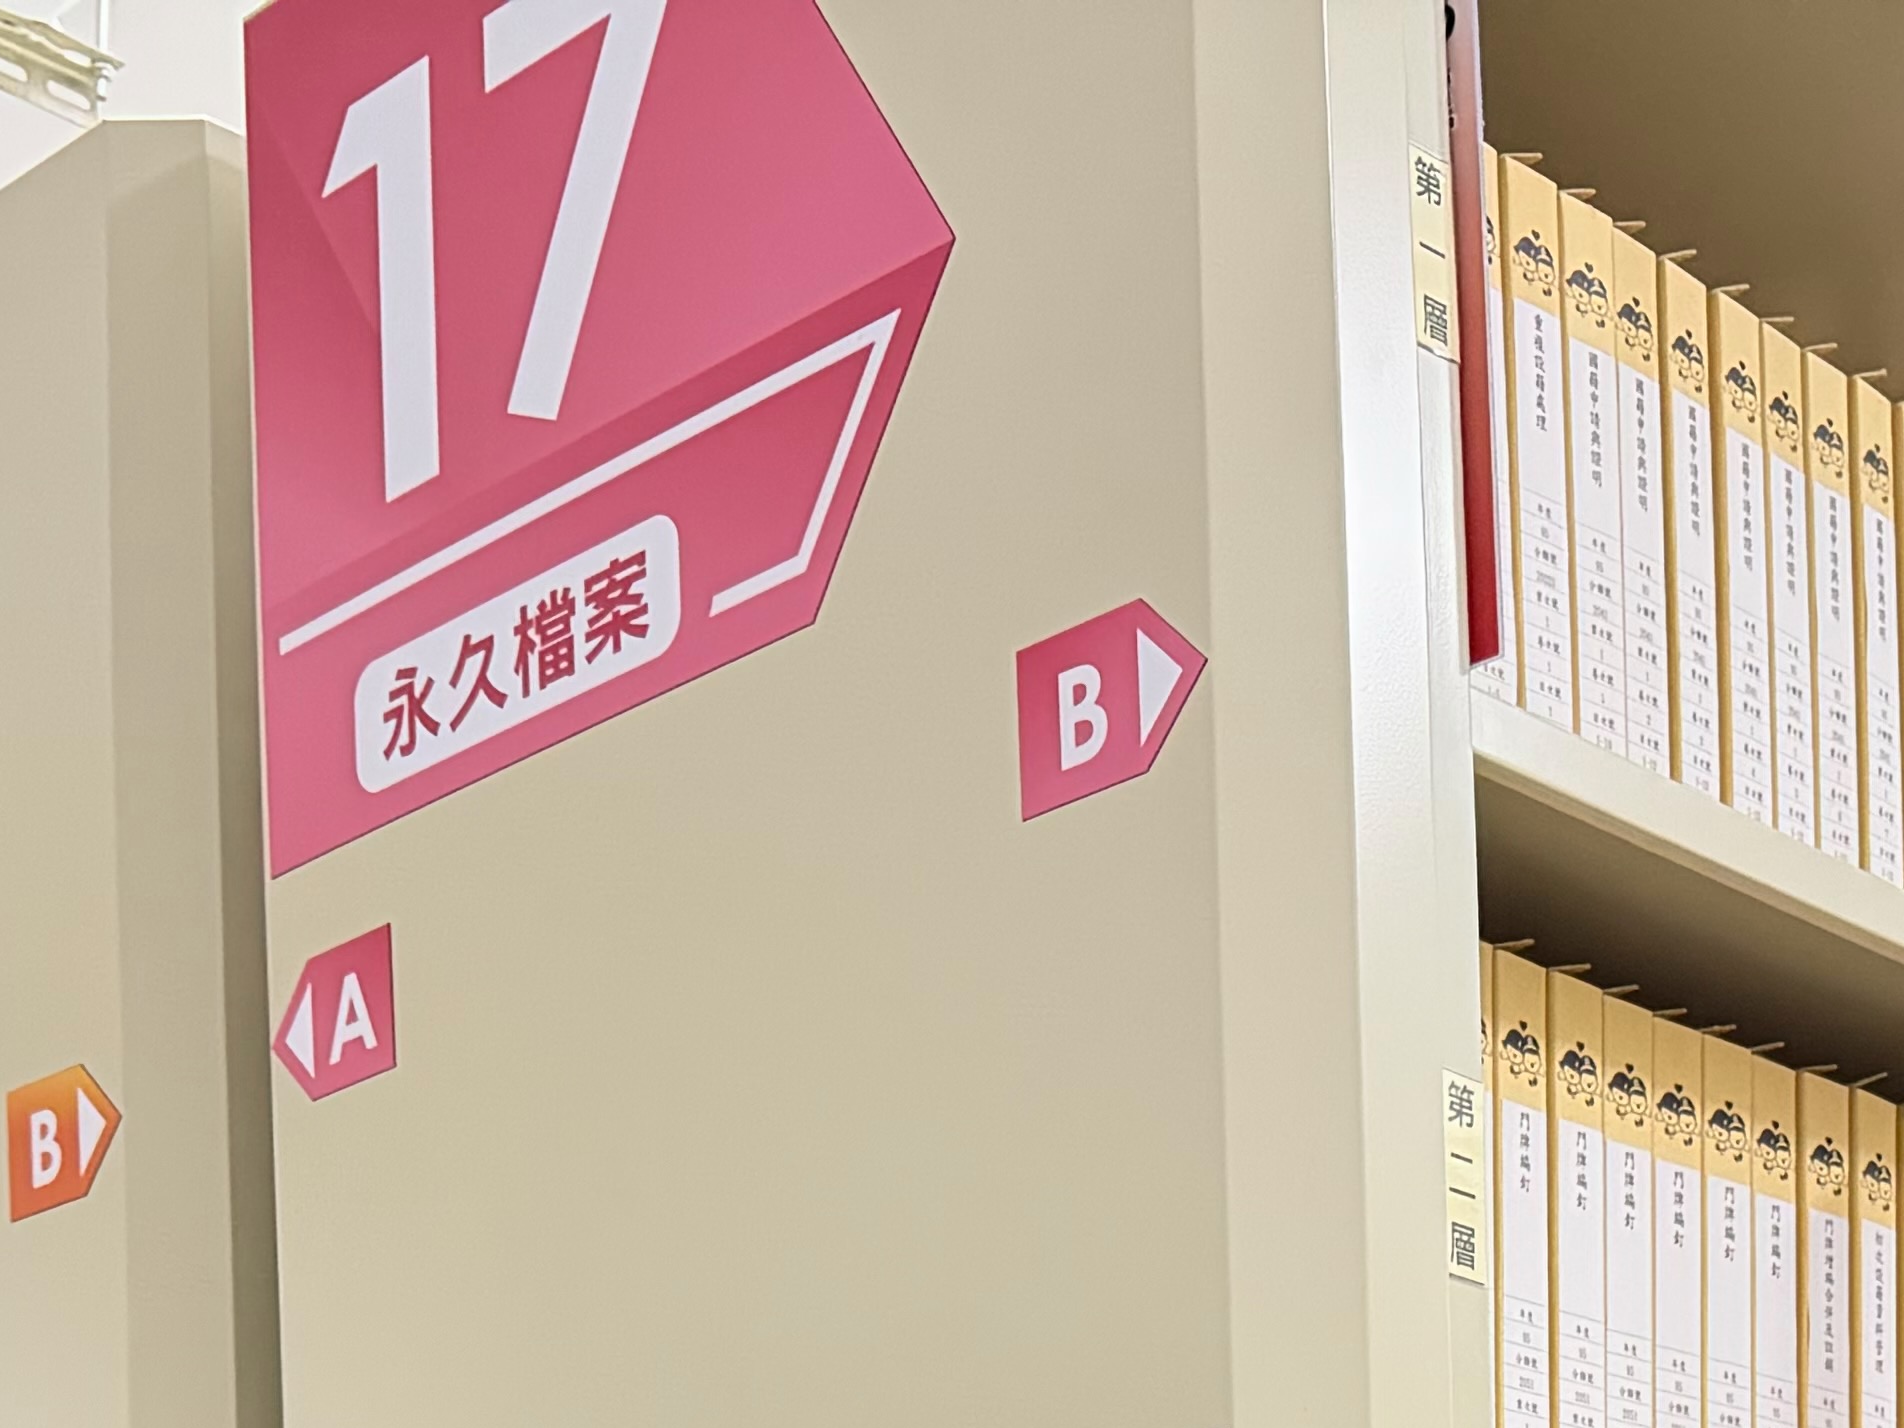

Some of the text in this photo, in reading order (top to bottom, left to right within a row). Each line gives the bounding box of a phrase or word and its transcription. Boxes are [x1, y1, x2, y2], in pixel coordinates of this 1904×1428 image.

[322, 0, 668, 503] 17
[1414, 156, 1448, 346] 第一層
[381, 548, 650, 761] 永久檔案
[1058, 664, 1108, 771] B
[329, 972, 378, 1066] A
[30, 1108, 62, 1189] B
[1448, 1080, 1478, 1271] 第二層
